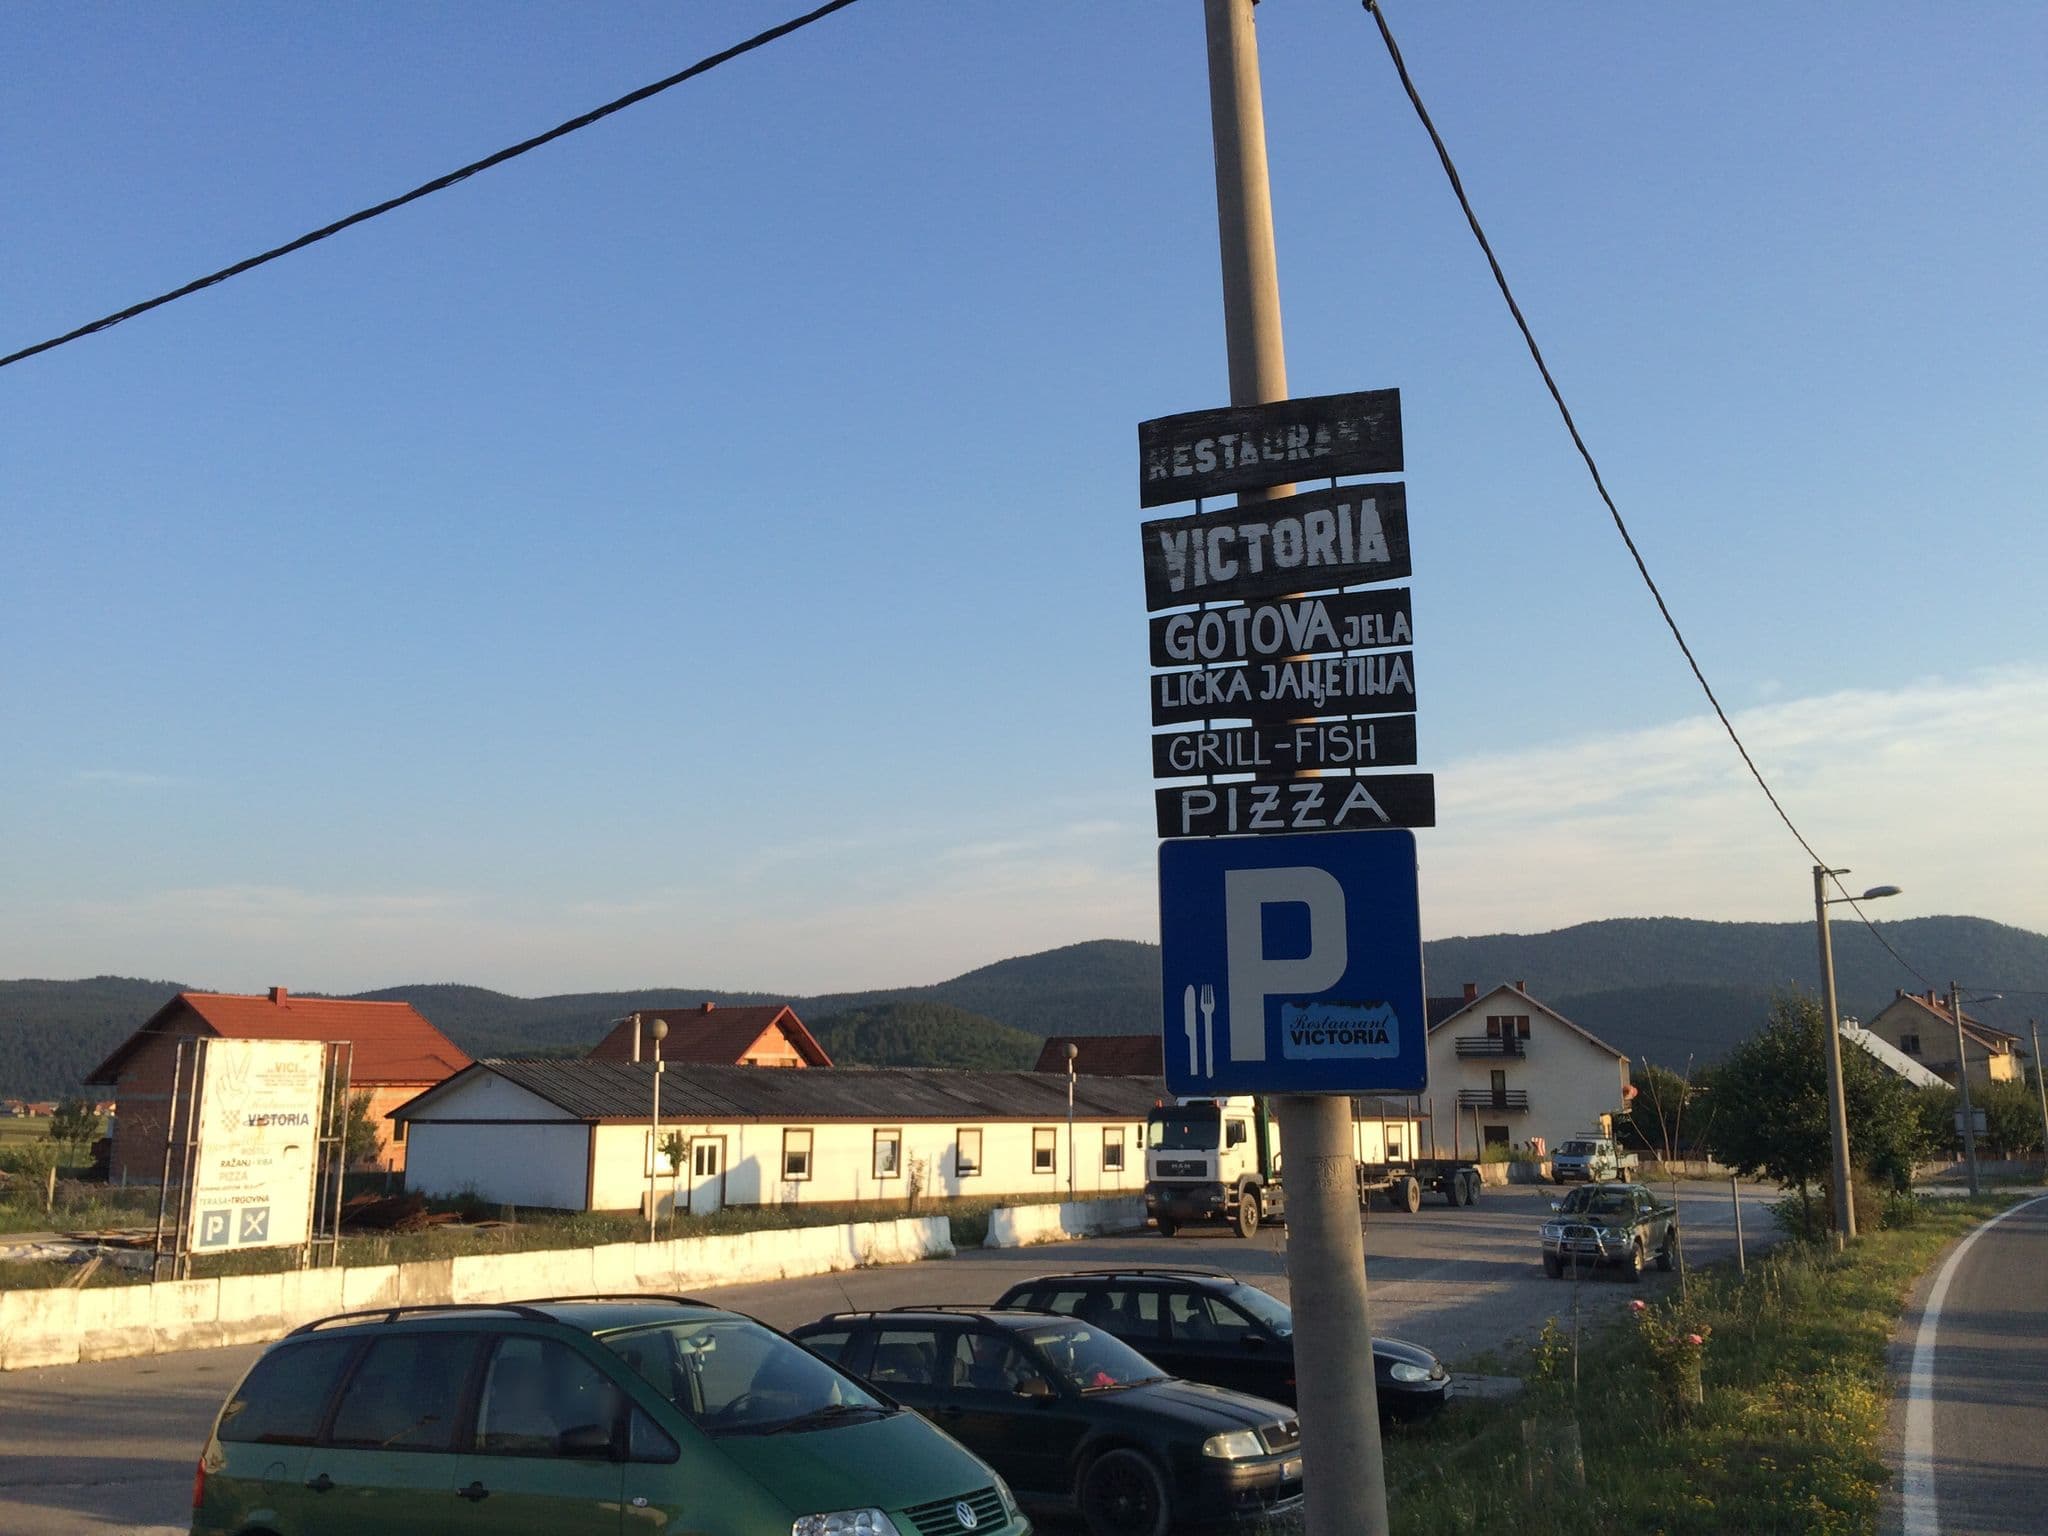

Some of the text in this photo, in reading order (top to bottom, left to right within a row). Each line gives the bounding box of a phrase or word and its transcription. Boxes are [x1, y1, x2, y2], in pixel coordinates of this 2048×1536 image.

[1161, 498, 1390, 592] VICTORIA
[1164, 600, 1412, 661] GOTOVA JELA
[1161, 660, 1252, 707] LIČKA
[1182, 782, 1391, 834] PIZZA
[1225, 866, 1348, 1061] P
[1290, 1029, 1390, 1046] VICTORIA
[248, 1113, 309, 1127] VICTORIA
[206, 1216, 224, 1241] P
